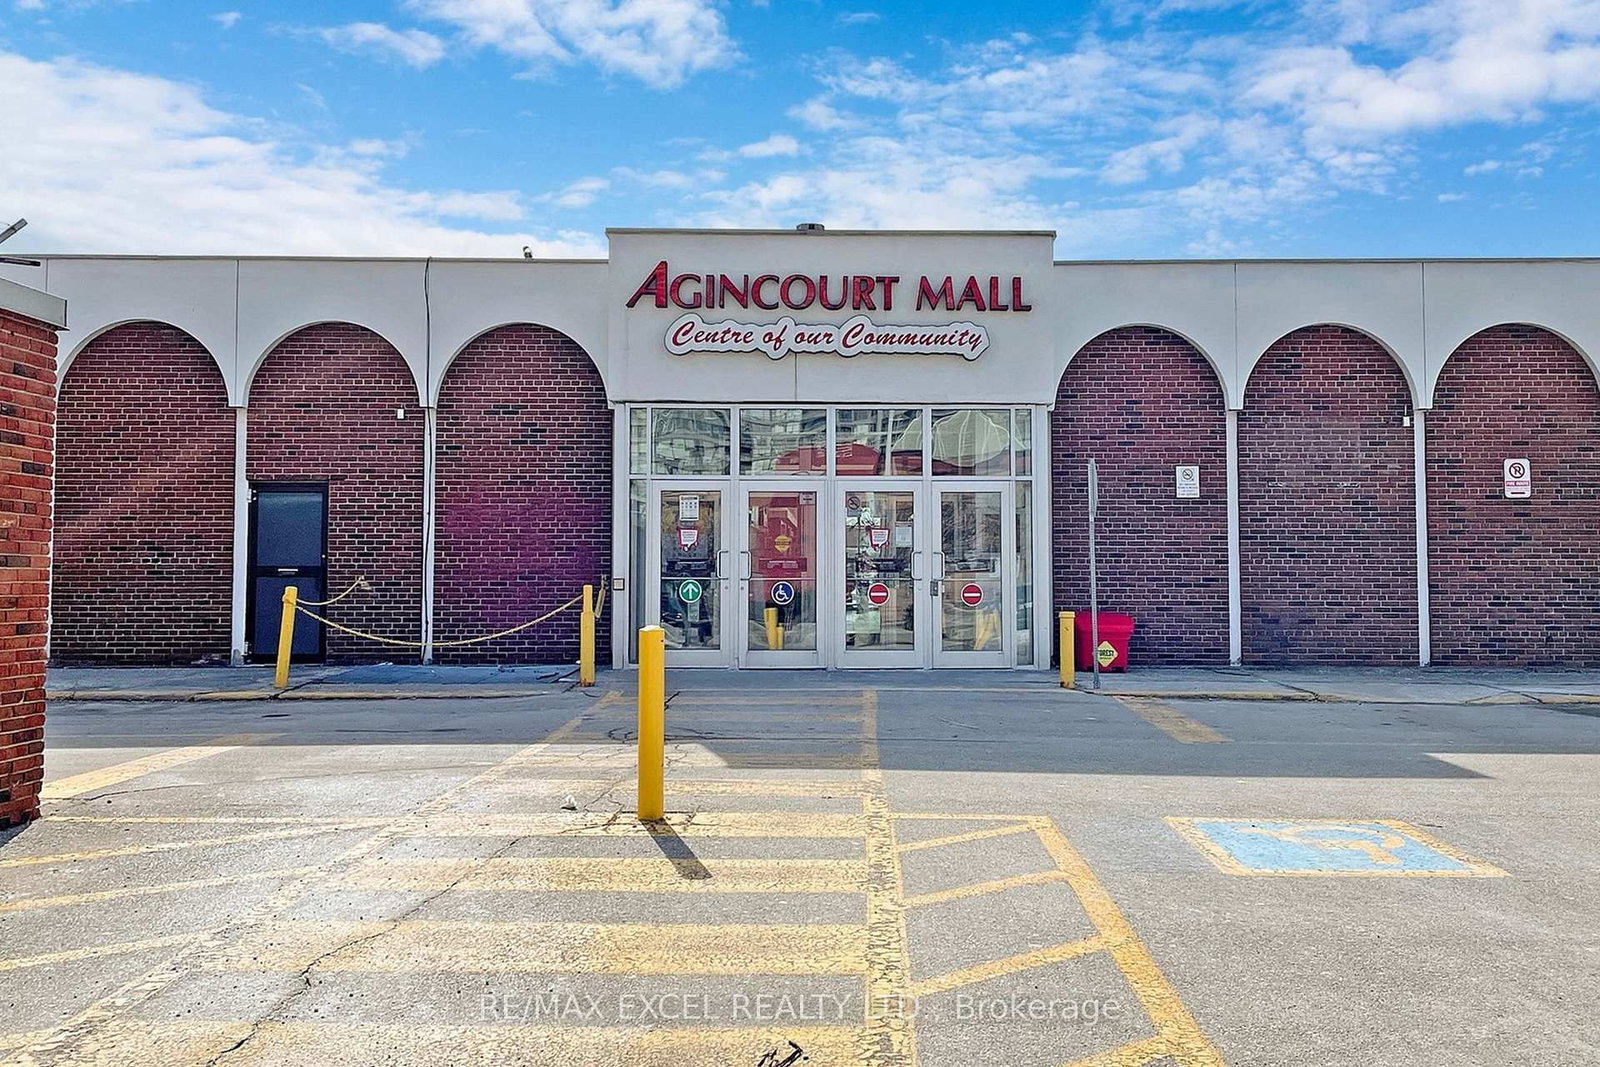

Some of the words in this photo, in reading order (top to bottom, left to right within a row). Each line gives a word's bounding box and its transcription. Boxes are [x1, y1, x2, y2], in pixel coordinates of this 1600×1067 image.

[625, 261, 900, 311] AGINCOURT
[916, 275, 1032, 311] MALL
[671, 321, 754, 346] Centre
[762, 325, 788, 351] of
[795, 333, 834, 345] our
[841, 323, 983, 352] Community
